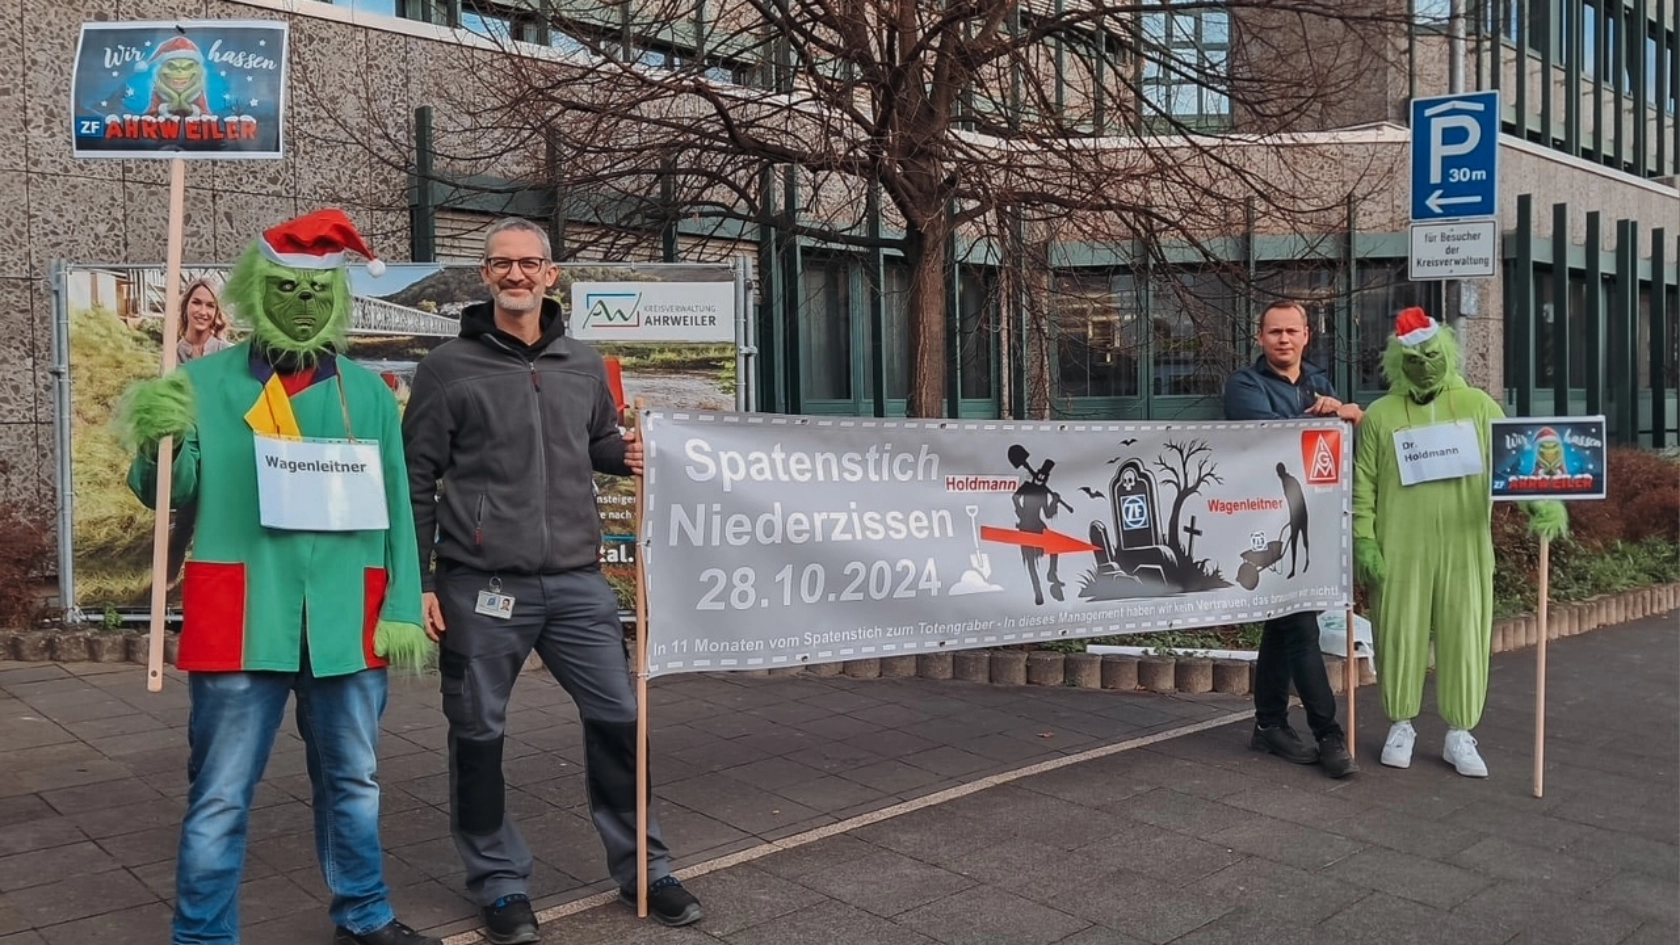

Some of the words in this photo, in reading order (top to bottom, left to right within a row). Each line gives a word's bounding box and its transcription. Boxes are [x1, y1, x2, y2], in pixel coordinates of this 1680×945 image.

[104, 45, 145, 69] Wir
[208, 39, 277, 71] hassen
[80, 121, 101, 134] ZF
[104, 114, 259, 141] AHRWEILER
[1429, 114, 1482, 185] P
[1424, 232, 1438, 243] für
[1440, 231, 1482, 243] Besucher
[1445, 244, 1460, 255] der
[1416, 255, 1490, 268] Kreisverwaltung
[644, 303, 717, 313] KREISVERWALTUNG
[644, 315, 717, 327] AHRWEILER
[1402, 441, 1418, 450] Dr.
[1505, 433, 1528, 450] Wir
[1564, 428, 1602, 448] hassen
[1404, 447, 1459, 463] Holdmann
[265, 455, 367, 474] Wagenleitner
[684, 438, 940, 492] Spatenstich
[946, 476, 1018, 491] Holdmann
[608, 510, 632, 519] nach
[1207, 497, 1283, 515] Wagenleitner
[668, 501, 954, 547] Niederzissen
[696, 557, 942, 611] 28.10.2024
[653, 643, 666, 656] In
[671, 638, 688, 653] 11
[694, 637, 764, 653] Monaten
[769, 635, 799, 648] vom
[803, 625, 882, 647] Spatenstich
[886, 625, 914, 638] zum
[918, 619, 995, 635] Totengräber
[1004, 616, 1015, 628] In
[1018, 614, 1055, 627] dieses
[1058, 607, 1123, 623] Management
[1126, 604, 1156, 618] haben
[1157, 603, 1173, 614] wir
[1174, 601, 1194, 613] kein
[1195, 598, 1250, 612] Vertrauen,
[1252, 595, 1269, 606] das
